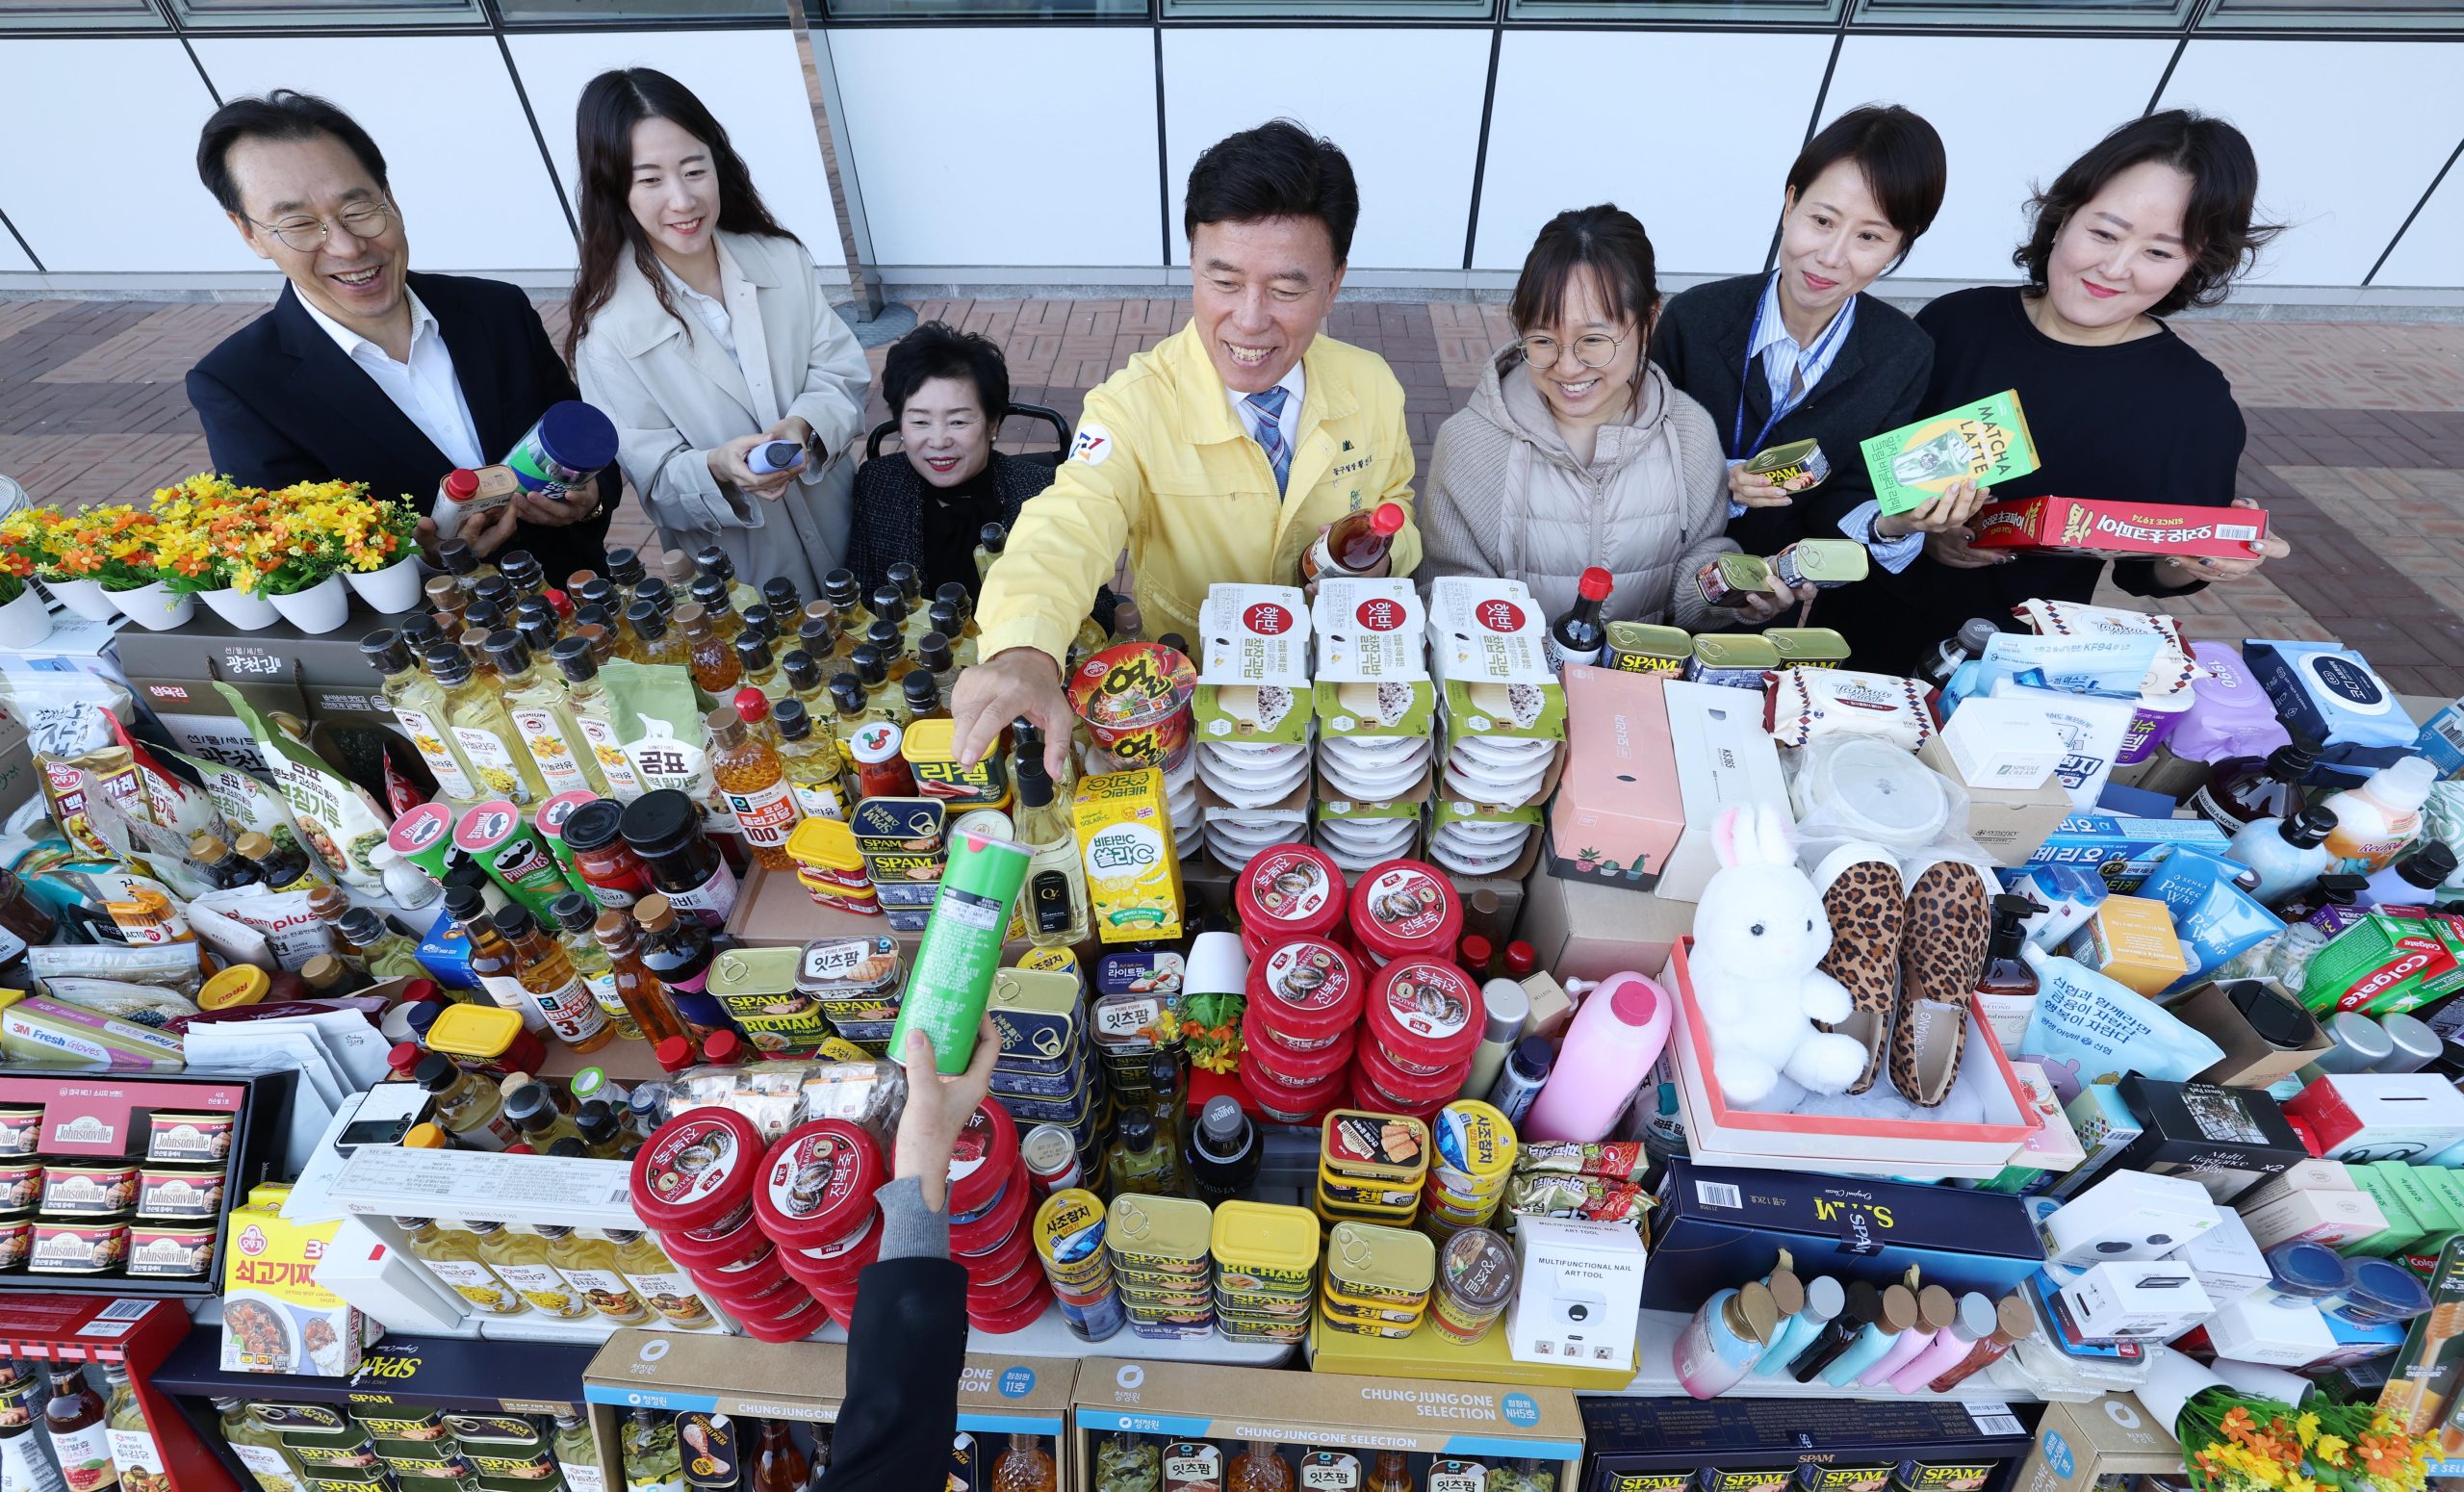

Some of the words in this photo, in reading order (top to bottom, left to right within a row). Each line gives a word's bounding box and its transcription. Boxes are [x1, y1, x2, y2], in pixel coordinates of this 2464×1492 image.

[1960, 421, 1989, 474] LATTE
[1978, 406, 2012, 476] MATCHA
[2060, 503, 2093, 545] 情
[2132, 514, 2155, 526] 1974
[2156, 517, 2185, 527] SINCE
[2096, 514, 2167, 544] 초코파이
[2166, 525, 2213, 544] 오리온
[1255, 604, 1278, 634] 햇반
[1367, 602, 1394, 630] 햇반
[1485, 602, 1514, 631] 햇반
[1355, 634, 1380, 678] 찰잡곡밥
[2083, 643, 2112, 653] KF94
[226, 656, 277, 674] 광천김
[1244, 638, 1265, 681] 찰잡곡밥
[1483, 635, 1510, 679] 찰잡곡밥
[1621, 656, 1678, 672] SPAM
[2208, 659, 2236, 689] 1990
[639, 751, 688, 774] 곰표
[51, 773, 77, 784] 오뚜기
[220, 773, 241, 789] 곰표
[1101, 786, 1147, 798] 비타민C
[399, 810, 434, 839] PRINGLES
[1080, 814, 1110, 827] SOLAR-C
[2211, 803, 2241, 831] SHAMPOO
[467, 812, 493, 839] PRINGLES
[745, 827, 779, 842] 100
[1093, 834, 1136, 847] 비타민C
[863, 838, 902, 848] SPAM
[1093, 843, 1154, 868] 쏠라C
[2034, 846, 2104, 862] 페리오
[502, 852, 551, 884] PRINGLES
[875, 857, 934, 868] SPAM
[1256, 857, 1291, 887] 전복죽
[244, 912, 319, 932] simplus
[1399, 911, 1440, 935] 전복죽
[145, 931, 159, 939] FIT
[2404, 939, 2440, 950] Colgate
[814, 951, 860, 973] 잇츠팜
[1108, 968, 1145, 977] 라이트팜
[1416, 967, 1457, 994] 전복죽
[1314, 972, 1347, 1005] 전복죽
[2342, 955, 2428, 1007] Colgate
[728, 995, 790, 1006] SPAM
[825, 1001, 884, 1012] SPAM
[2051, 989, 2090, 1015] 금융이
[2053, 976, 2092, 1001] 신협과
[2095, 995, 2152, 1036] 함께라면
[1107, 1009, 1149, 1029] 잇츠팜
[2044, 999, 2085, 1027] 행복이
[556, 1020, 580, 1037] 3
[744, 1016, 822, 1034] RICHAM
[13, 1023, 30, 1036] 3M
[33, 1030, 64, 1046] Fresh
[66, 1041, 101, 1057] Gloves
[2040, 1016, 2056, 1030] 평생
[2056, 1027, 2080, 1041] 어부바
[2093, 1042, 2113, 1055] 신협
[1211, 1106, 1235, 1122] BARISTA
[1654, 1118, 1673, 1131] 곰표
[56, 1126, 112, 1142] Johnsonville
[1341, 1121, 1374, 1160] Johnsonville
[1476, 1114, 1493, 1164] 사조참치
[156, 1135, 209, 1150] Johnsonville
[654, 1127, 700, 1165] 전복죽
[2214, 1151, 2246, 1161] Multi
[830, 1152, 852, 1197] 전복죽
[50, 1186, 104, 1201] Johnsonville
[146, 1190, 201, 1205] Johnsonville
[1046, 1205, 1091, 1234] 사조참치
[37, 1243, 90, 1259] Johnsonville
[244, 1238, 263, 1249] 오뚜기
[135, 1248, 189, 1264] Johnsonville
[1538, 1257, 1612, 1271] MULTIFUNCTIONAL
[1224, 1264, 1309, 1278] RICHAM
[1464, 1259, 1497, 1297] 장조림
[630, 1363, 658, 1375] 청정원
[1007, 1372, 1030, 1381] 청정원
[1005, 1381, 1026, 1393] 11호
[349, 1394, 394, 1403] SPAM
[642, 1395, 668, 1406] 청정원
[1114, 1390, 1141, 1402] 청정원
[1507, 1399, 1531, 1408] 청정원
[1416, 1404, 1496, 1420] SELECTION
[1505, 1407, 1536, 1420] NH5호
[367, 1420, 425, 1431] SPAM
[690, 1414, 728, 1447] WOORIPAM
[1132, 1418, 1160, 1430] 청정원
[1350, 1434, 1417, 1448] SELECTION
[2126, 1431, 2156, 1445] 청정원
[117, 1449, 149, 1459] 튀김유
[1798, 1453, 1835, 1463] SPAM
[389, 1459, 445, 1470] SPAM
[477, 1458, 532, 1470] SPAM
[1170, 1461, 1211, 1478] 잇츠팜
[1309, 1470, 1349, 1485] 잇츠팜
[1725, 1474, 1784, 1486] SPAM
[1823, 1471, 1883, 1484] SPAM
[1923, 1467, 1983, 1479] SPAM
[1436, 1476, 1477, 1491] 잇츠팜
[1620, 1477, 1681, 1492] SPAM
